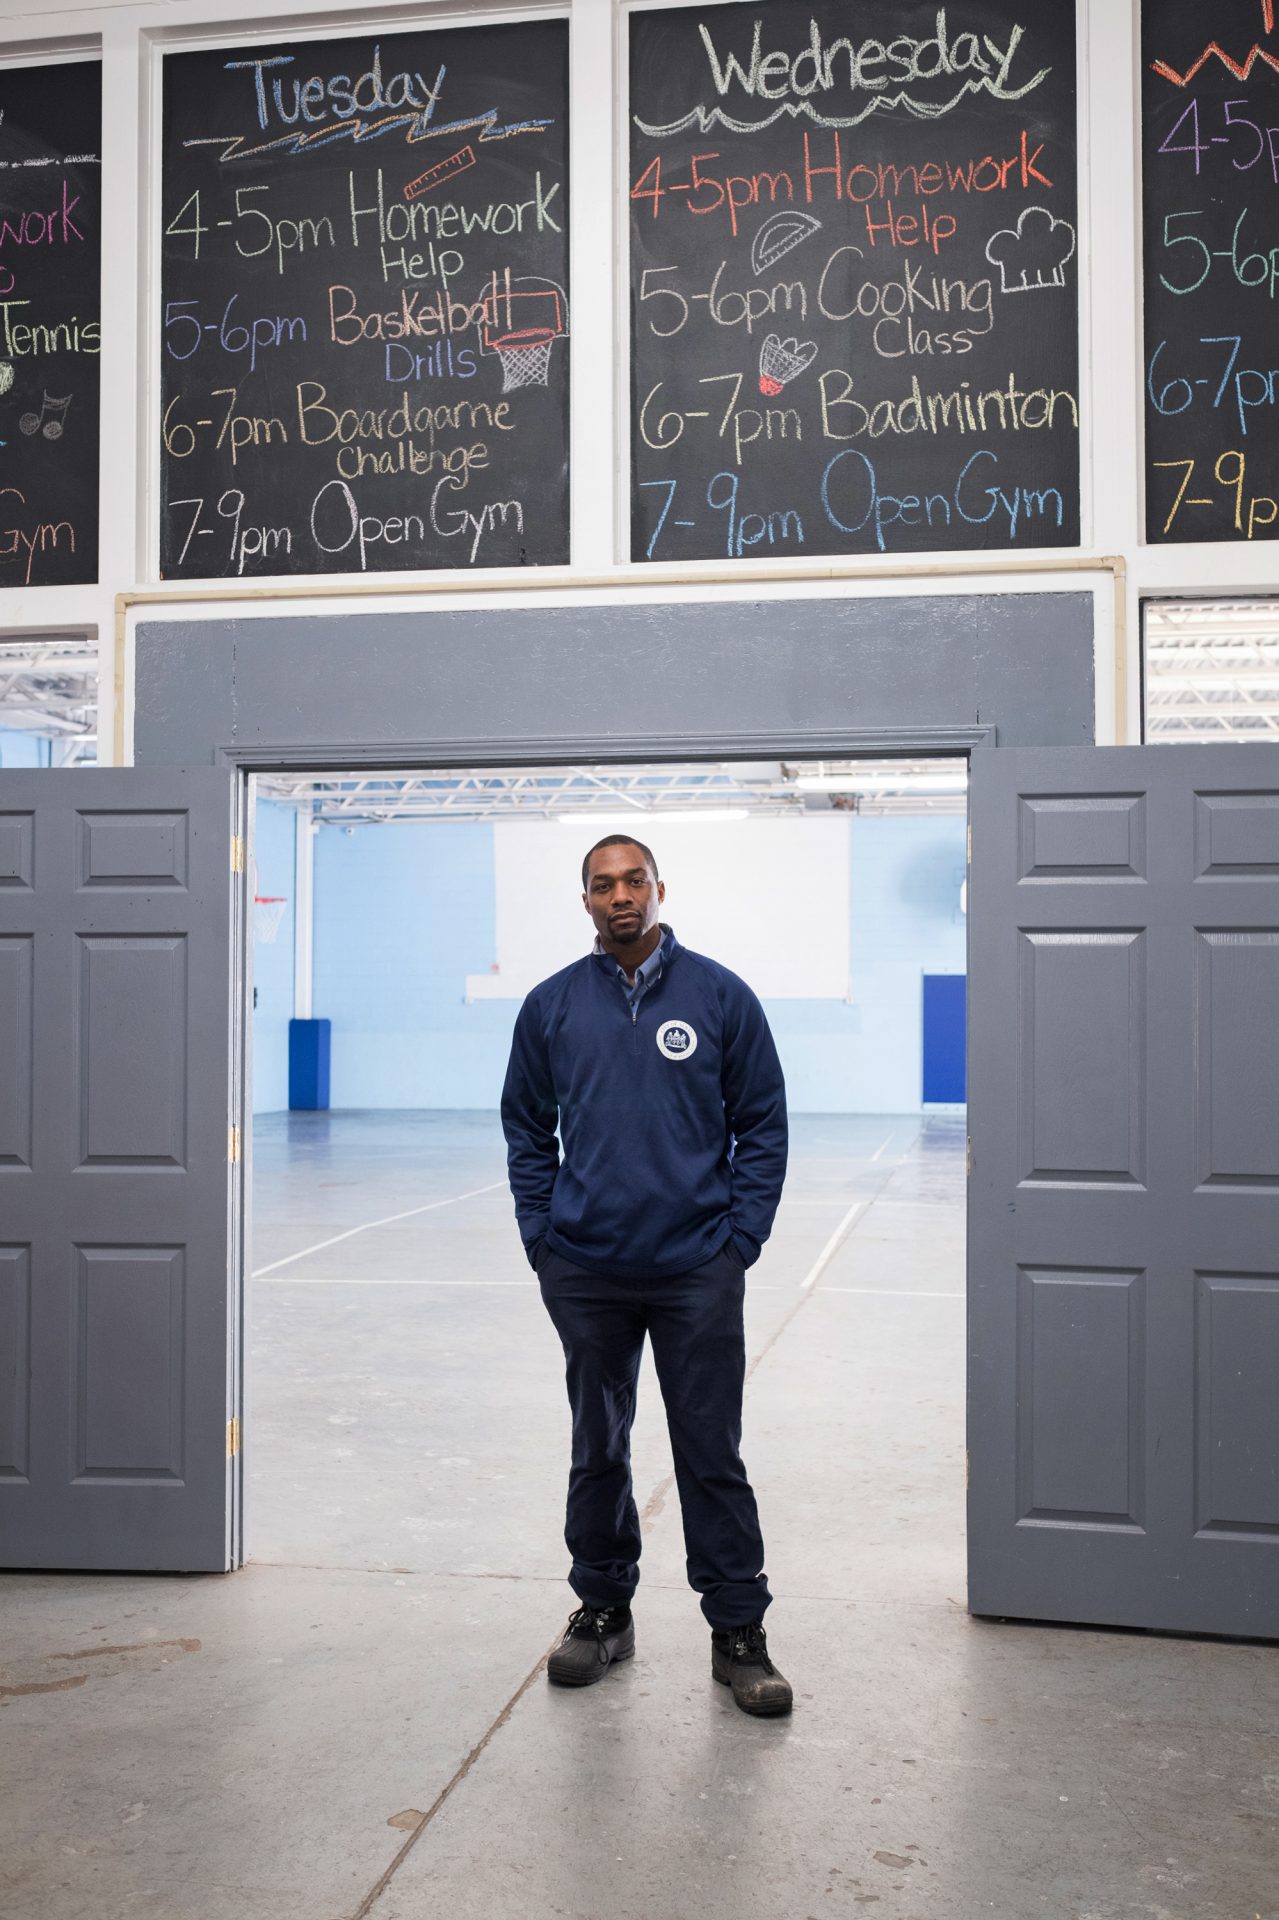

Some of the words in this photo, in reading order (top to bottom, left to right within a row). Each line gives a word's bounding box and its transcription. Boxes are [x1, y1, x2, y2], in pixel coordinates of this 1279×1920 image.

[223, 44, 447, 129] Tuesday
[699, 7, 1026, 98] Wednesday
[165, 185, 336, 274] 4-5pm
[349, 168, 562, 247] Homework
[629, 152, 795, 237] 4-5pm
[803, 129, 1054, 203] Homework
[380, 241, 464, 289] Help
[865, 199, 957, 255] Help
[0, 299, 101, 357] Tennis
[164, 293, 308, 371] 5-6pm
[639, 260, 808, 337] 5-6pm
[817, 245, 995, 334] Cooking
[385, 338, 478, 383] Drills
[873, 316, 975, 359] Class
[162, 387, 289, 466] 6-7pm
[296, 381, 516, 452] Boardgame
[639, 372, 803, 465] 6-7pm
[817, 369, 1079, 440] Badminton
[168, 488, 292, 576] 7-9pm
[310, 479, 425, 571] Open
[429, 475, 524, 564] Gym
[639, 471, 805, 560] 7-9pm
[820, 448, 951, 552] Open
[954, 449, 1063, 539] Gym
